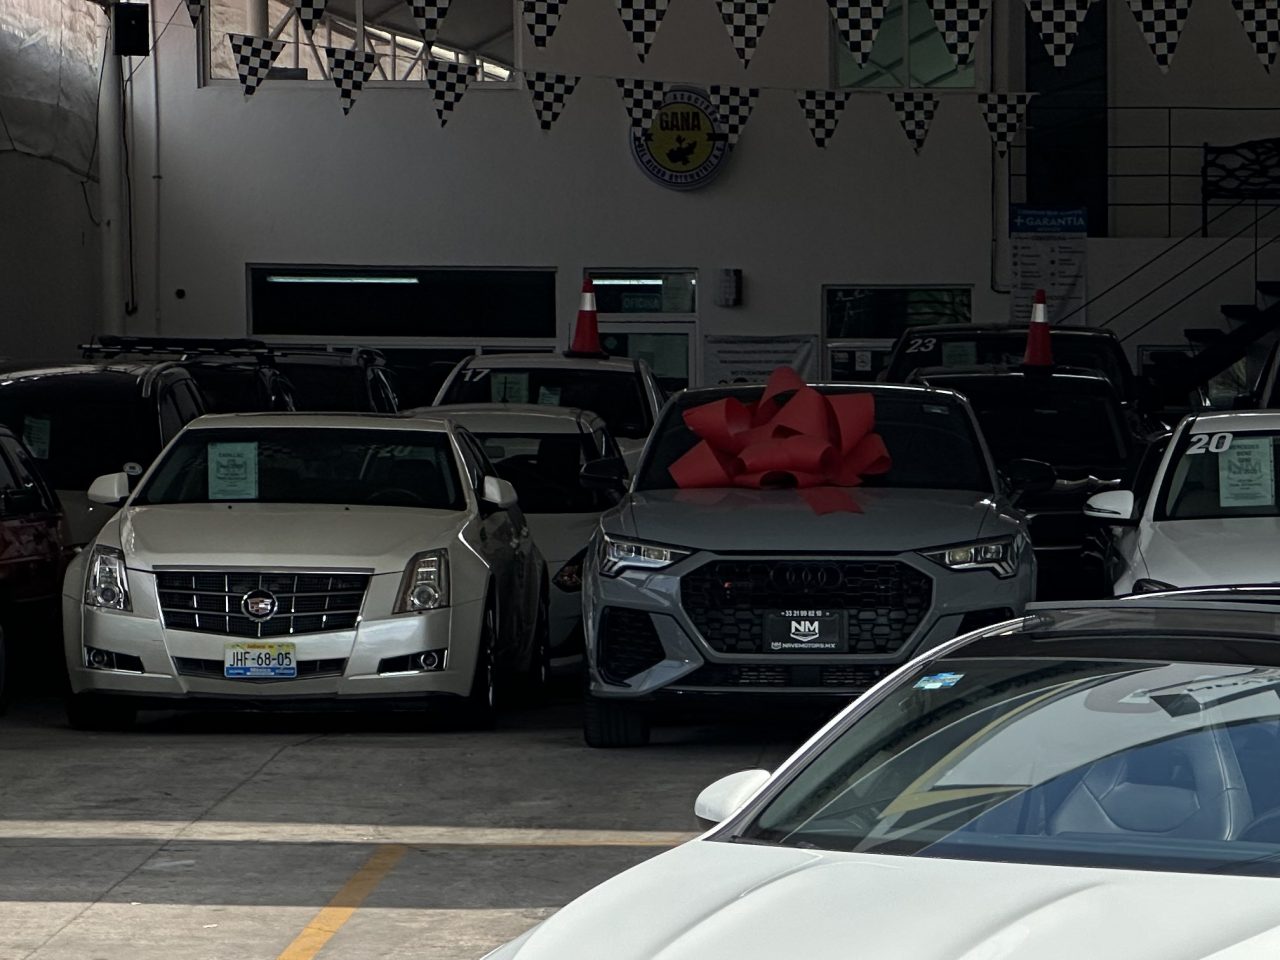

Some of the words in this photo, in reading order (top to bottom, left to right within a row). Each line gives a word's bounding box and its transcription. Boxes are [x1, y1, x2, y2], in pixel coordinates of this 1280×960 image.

[660, 111, 701, 132] GANA
[905, 338, 938, 354] 23
[461, 368, 491, 382] 17
[1185, 432, 1234, 455] 20
[791, 620, 819, 634] NM
[229, 651, 292, 666] JHF-68-05
